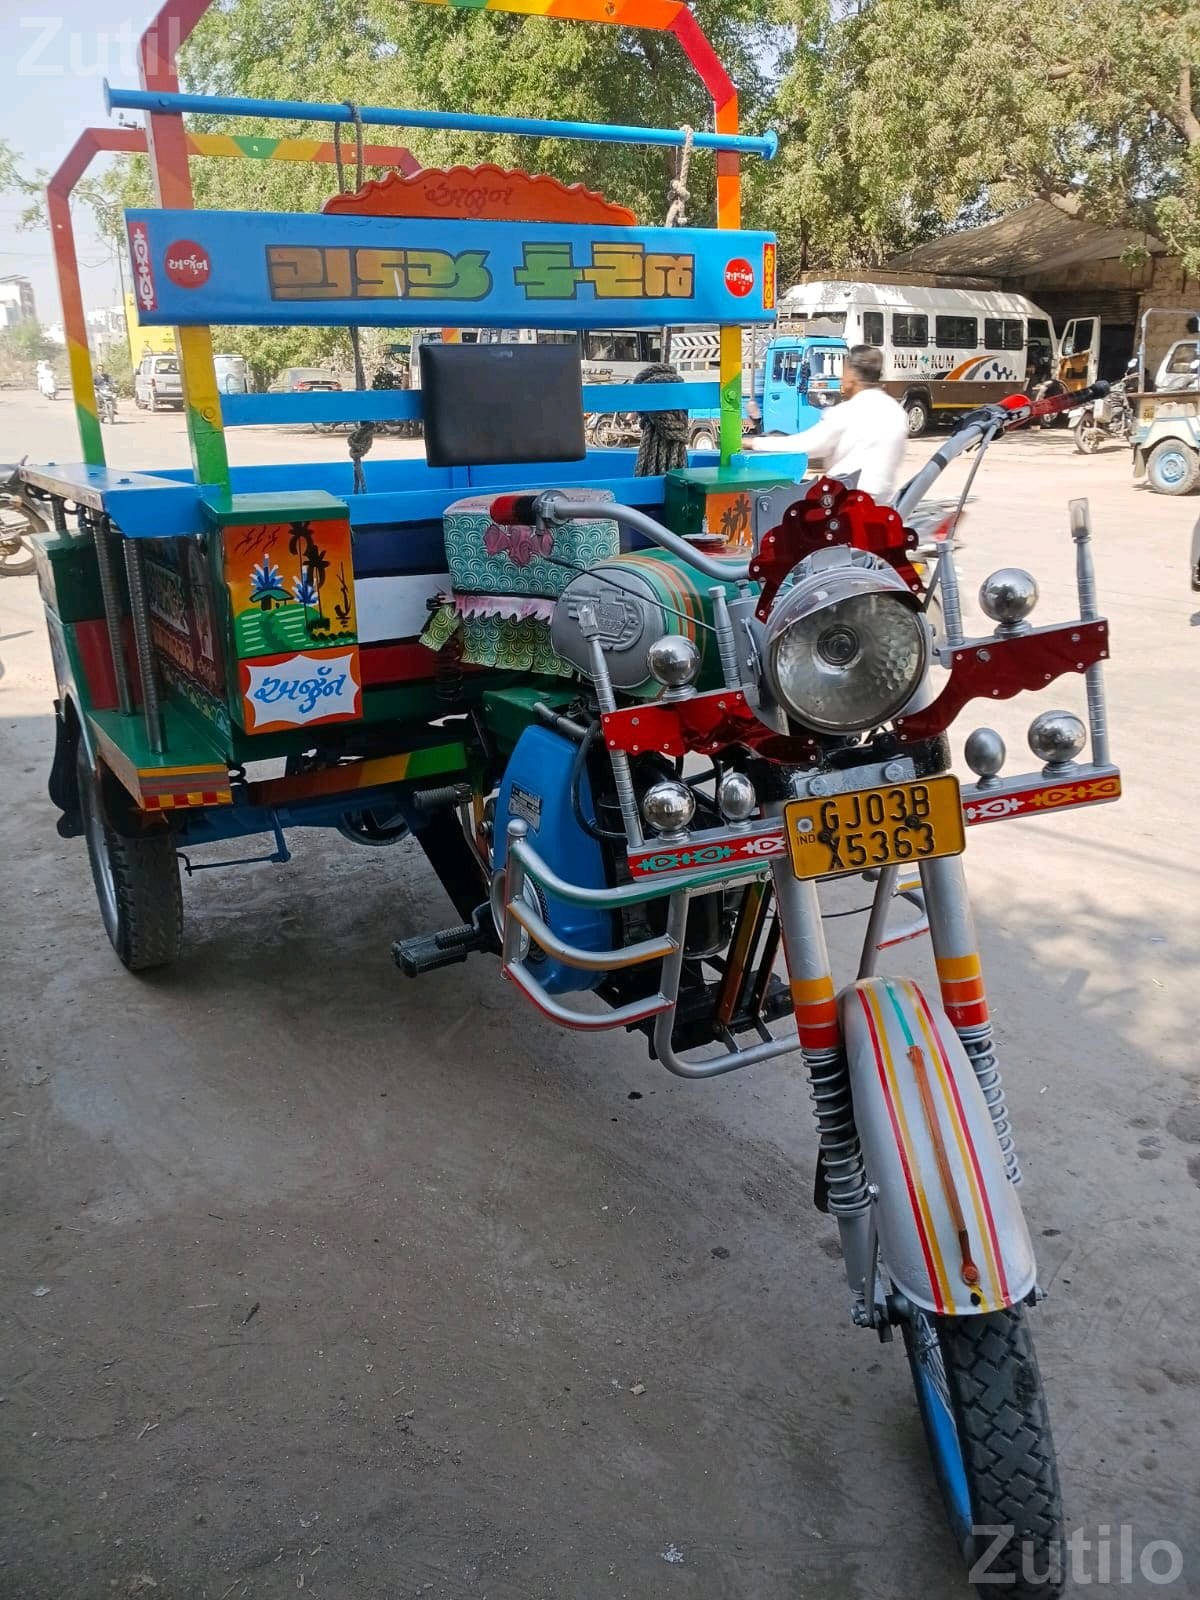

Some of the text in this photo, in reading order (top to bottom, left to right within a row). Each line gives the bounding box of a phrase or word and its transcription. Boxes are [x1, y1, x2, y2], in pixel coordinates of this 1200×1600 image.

[894, 354, 955, 369] KUM KUM
[254, 666, 347, 714] અર્જુન
[820, 784, 931, 832] GJ03B
[796, 833, 816, 846] IND
[828, 821, 936, 871] X5363
